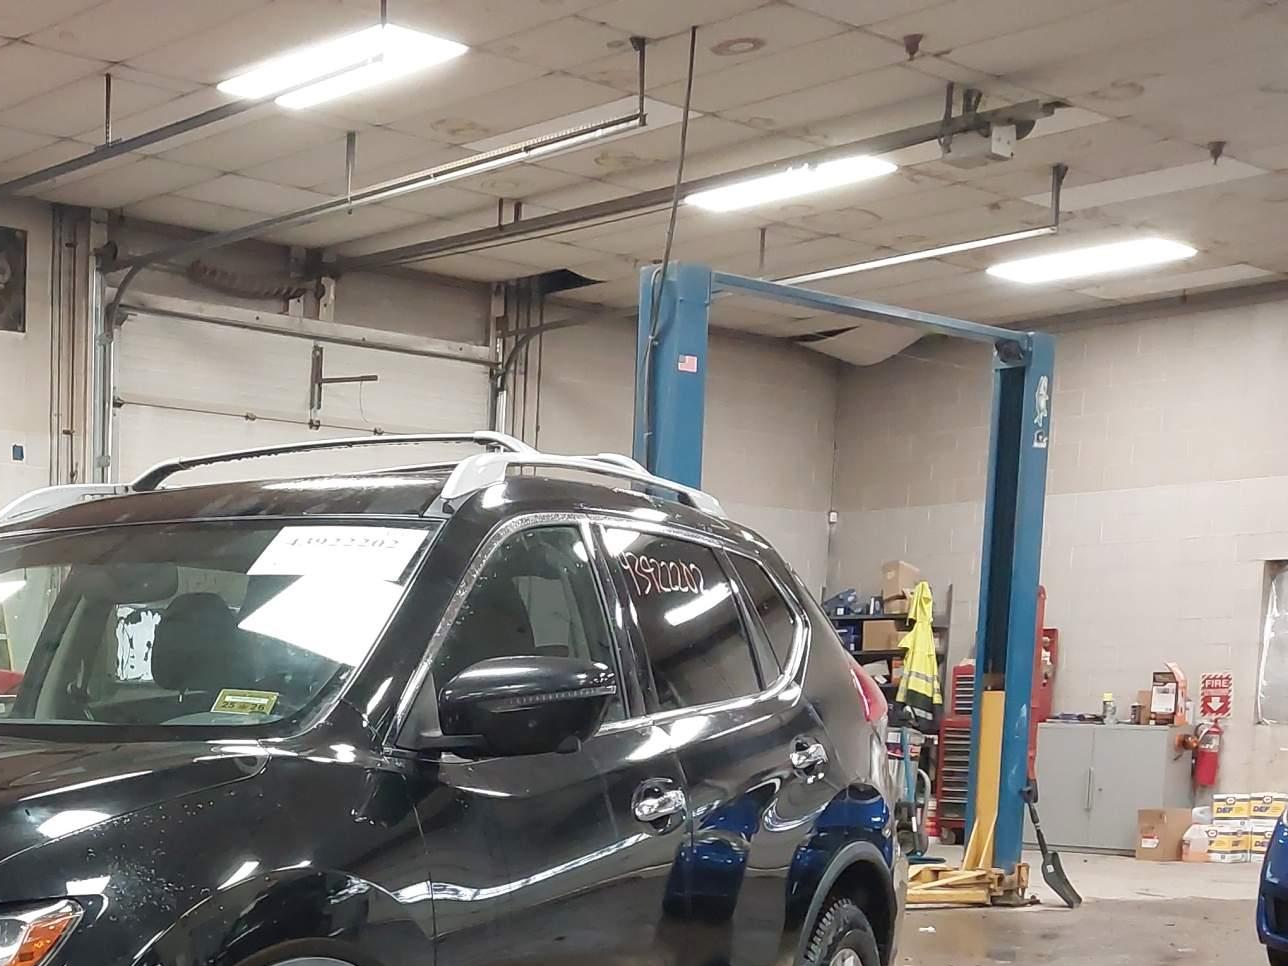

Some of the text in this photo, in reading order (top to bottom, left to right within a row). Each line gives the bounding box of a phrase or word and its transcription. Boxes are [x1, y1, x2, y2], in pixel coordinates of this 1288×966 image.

[616, 551, 704, 595] 43922202
[1205, 679, 1230, 688] FIRE
[221, 701, 235, 709] 25
